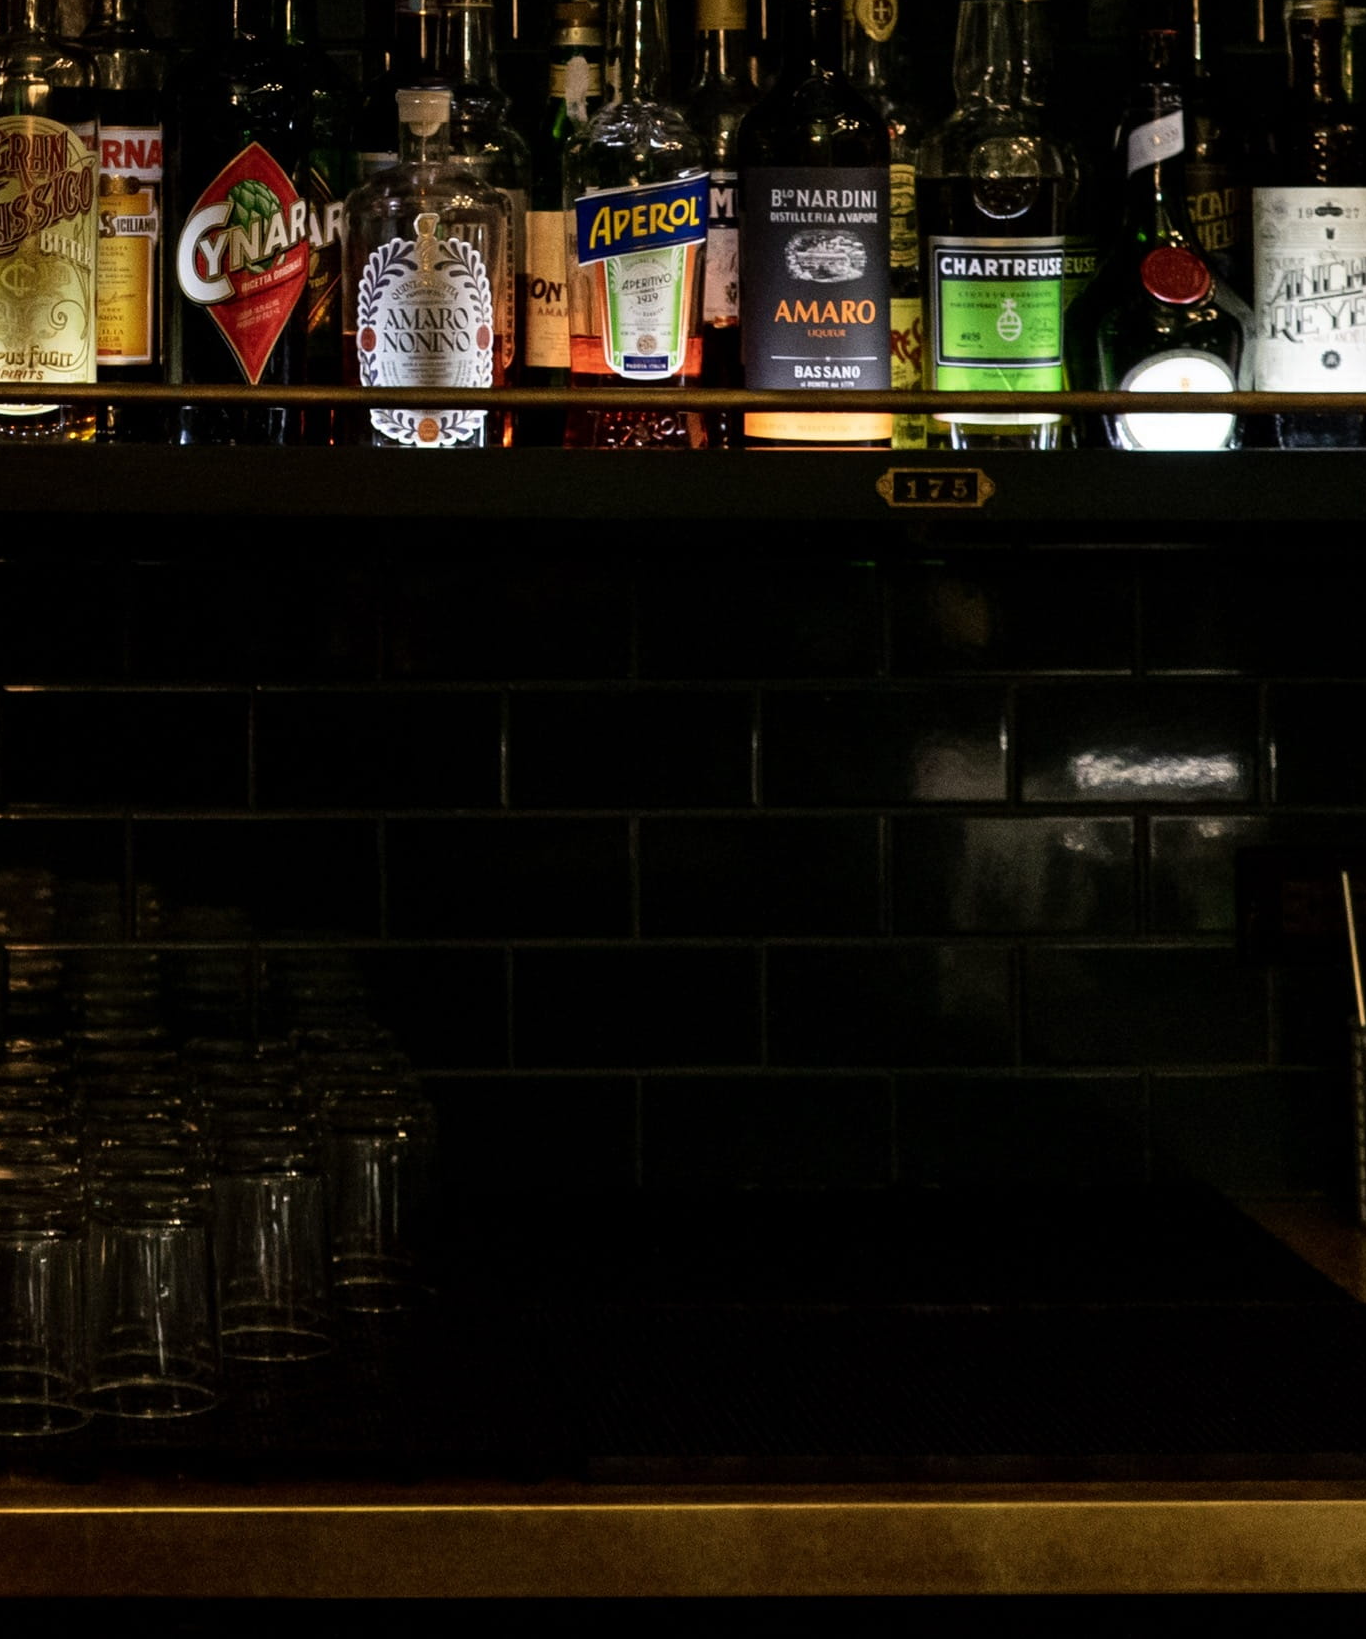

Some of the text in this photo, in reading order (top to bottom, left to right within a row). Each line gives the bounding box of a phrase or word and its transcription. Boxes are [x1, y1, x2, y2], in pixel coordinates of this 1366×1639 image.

[796, 189, 877, 208] NARDINI
[588, 195, 701, 250] APEROL
[770, 211, 835, 224] DISTILLERIA
[1298, 207, 1314, 220] 19
[177, 198, 307, 304] CYNAR
[939, 258, 1063, 277] CHARTREUSE
[620, 273, 673, 291] APERITIVO
[636, 292, 659, 305] 1919
[384, 307, 469, 331] AMARO
[773, 299, 876, 325] AMARO
[382, 330, 471, 354] NONINO
[806, 329, 847, 338] LIQUEUR
[29, 342, 74, 367] FUGIT
[793, 365, 861, 380] BASSANO
[905, 479, 970, 499] 175
